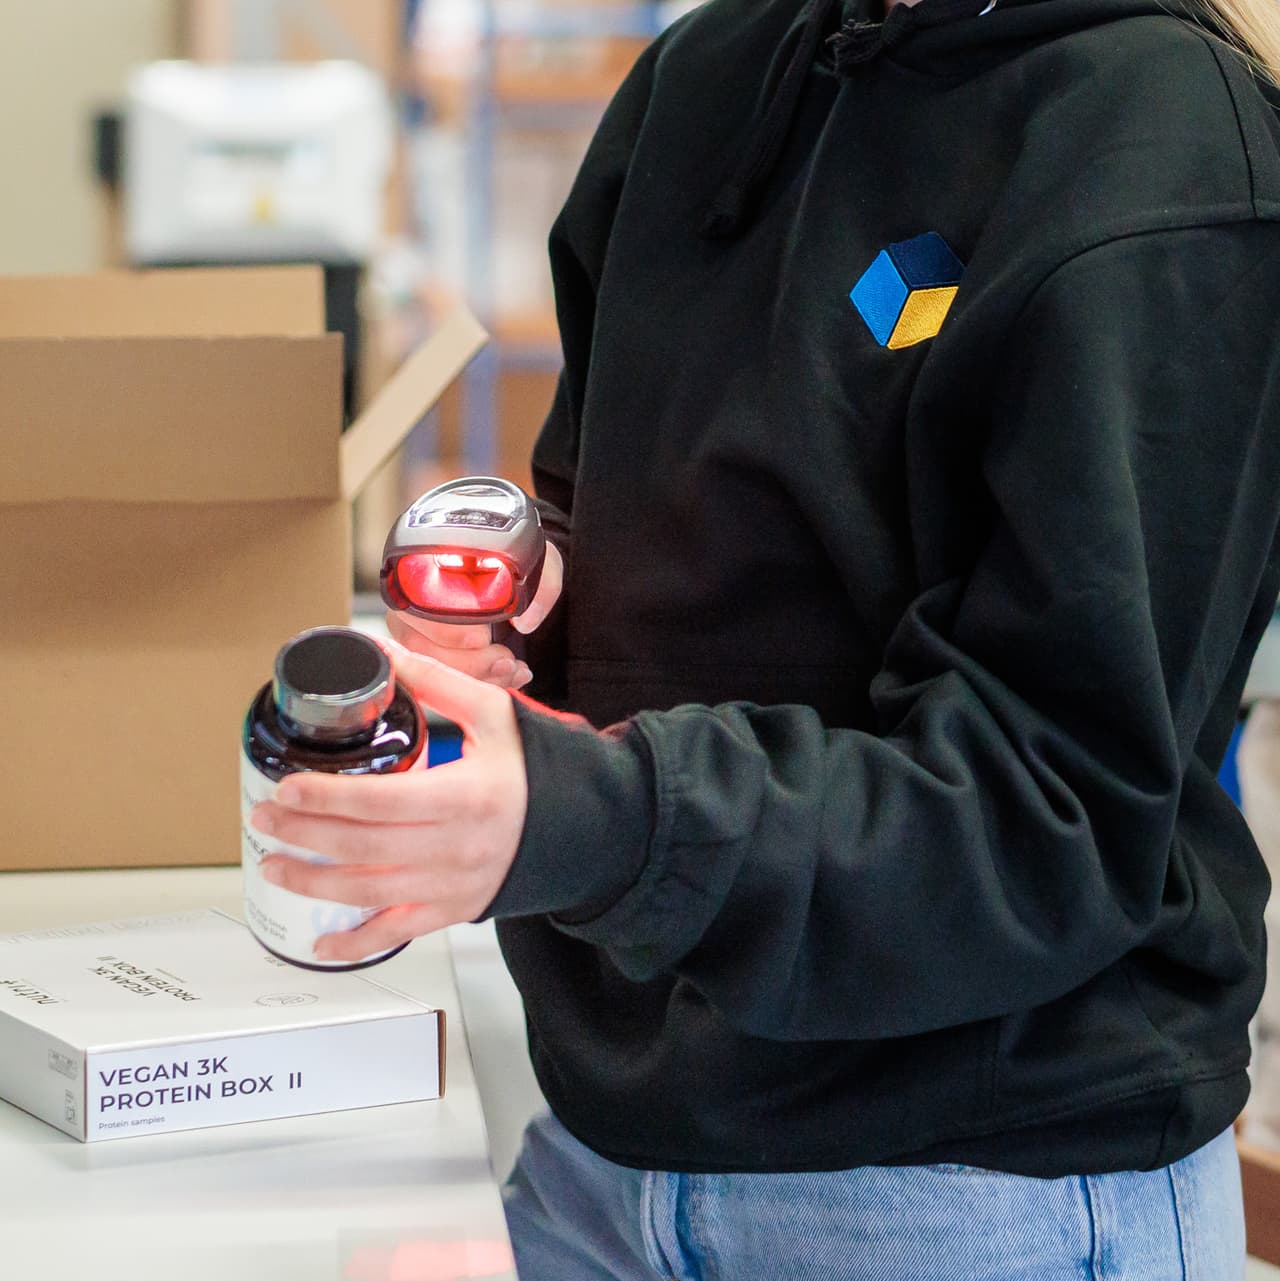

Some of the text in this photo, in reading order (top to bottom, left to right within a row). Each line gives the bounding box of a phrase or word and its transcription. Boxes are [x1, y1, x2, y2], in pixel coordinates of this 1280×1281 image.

[99, 1056, 229, 1087] VEGAN 3K
[100, 1083, 212, 1113] PROTEIN
[221, 1075, 274, 1098] BOX
[98, 1115, 166, 1131] Protein samples
